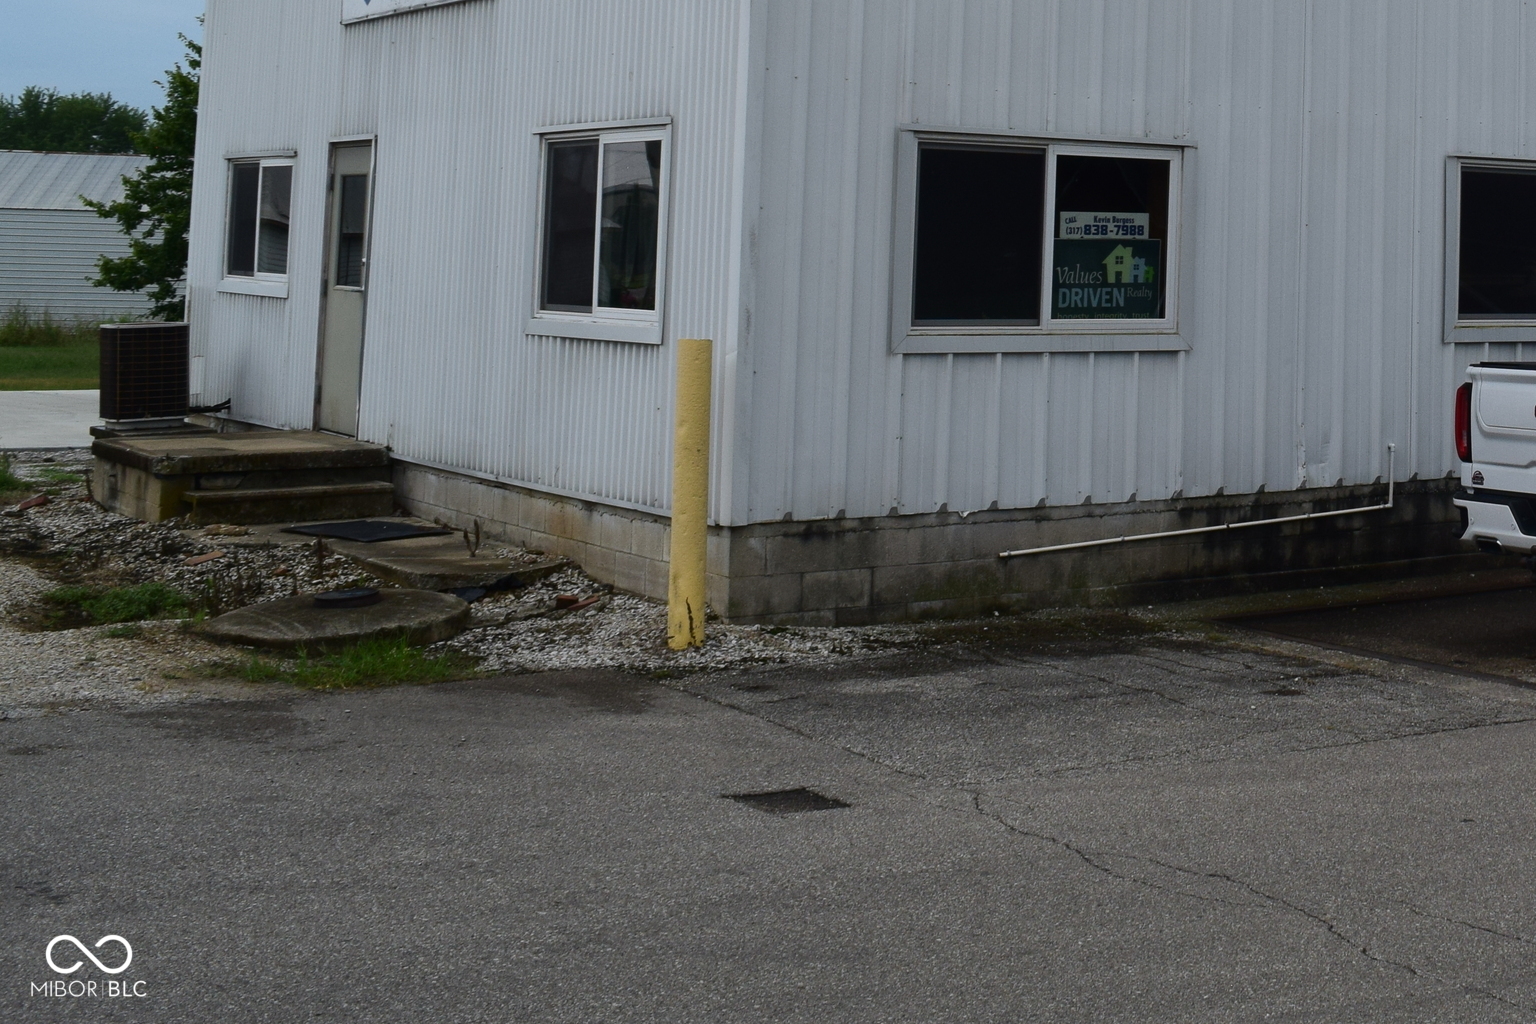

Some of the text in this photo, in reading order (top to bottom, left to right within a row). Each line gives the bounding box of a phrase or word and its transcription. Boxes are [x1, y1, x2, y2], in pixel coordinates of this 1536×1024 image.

[1064, 216, 1077, 224] CALL
[1093, 215, 1135, 225] Kevin Burgess
[1065, 226, 1083, 235] (317)
[1056, 263, 1103, 284] Values
[1058, 286, 1153, 308] DRIVEN Realty
